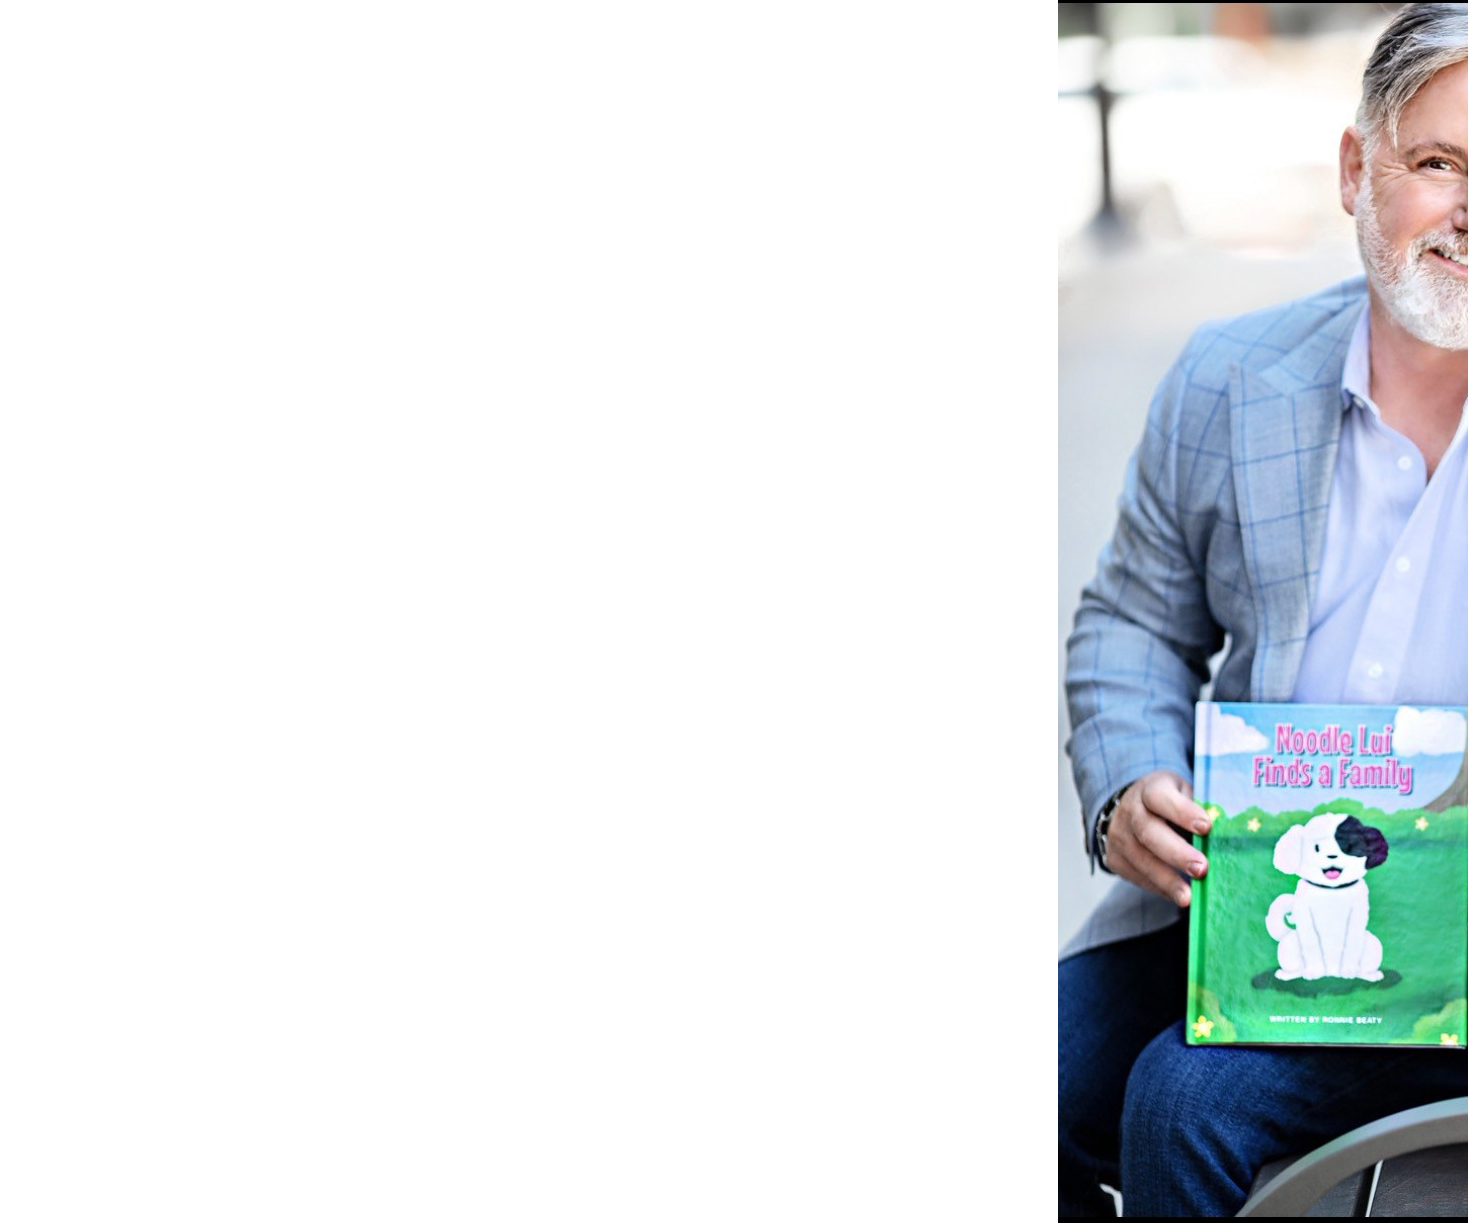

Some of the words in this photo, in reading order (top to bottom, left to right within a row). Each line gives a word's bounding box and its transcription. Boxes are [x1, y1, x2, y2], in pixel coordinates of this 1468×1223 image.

[1275, 724, 1353, 755] Noodle
[1358, 724, 1393, 756] Lui
[1252, 756, 1312, 788] Finds
[1317, 763, 1332, 788] a
[1338, 758, 1413, 795] Family
[1269, 1015, 1306, 1024] WRITTEN
[1308, 1015, 1320, 1024] BY
